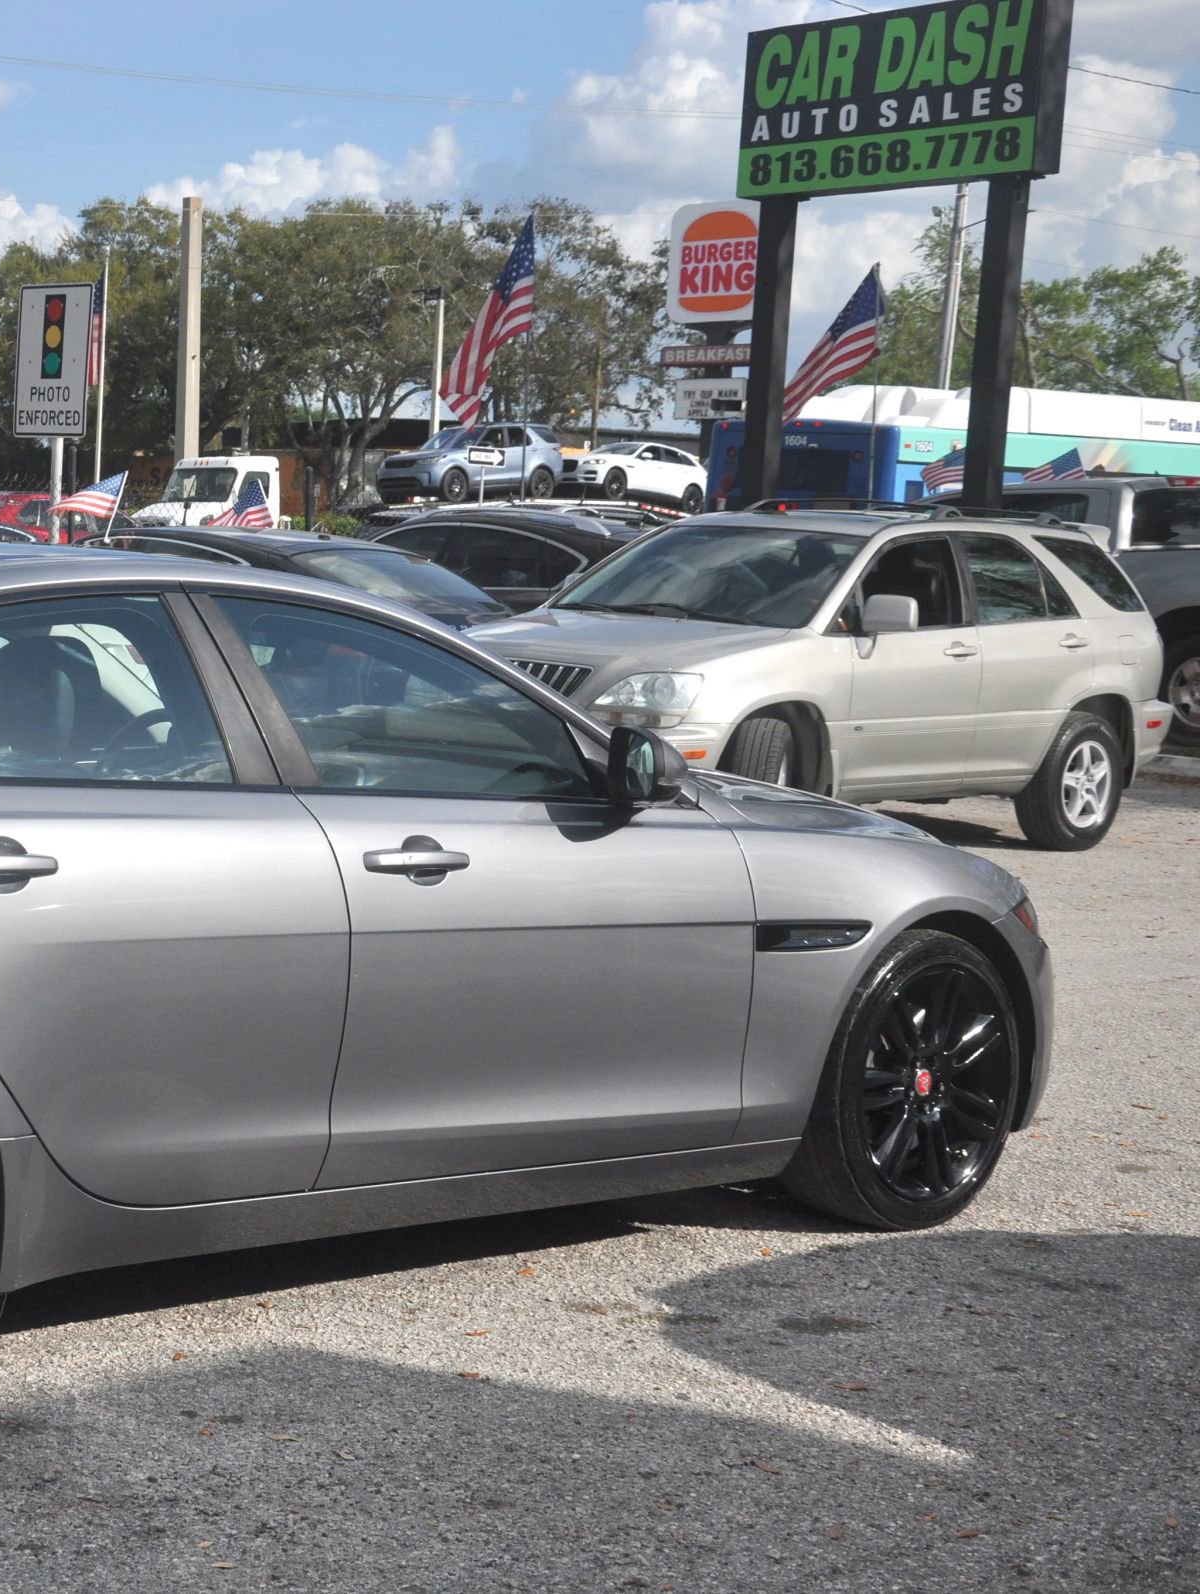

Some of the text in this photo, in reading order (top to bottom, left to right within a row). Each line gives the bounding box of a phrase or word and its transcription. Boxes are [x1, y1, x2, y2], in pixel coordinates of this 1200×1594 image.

[755, 0, 1034, 110] CAR DASH
[750, 83, 1024, 142] AUTO SALES
[749, 126, 1021, 187] 813.668.7778
[681, 240, 757, 266] BURGER
[679, 262, 755, 295] KING
[665, 347, 750, 362] BREAKFAST
[30, 386, 70, 402] PHOTO
[18, 410, 81, 426] ENFORCED
[1169, 418, 1193, 432] Clean
[784, 435, 808, 447] 1604
